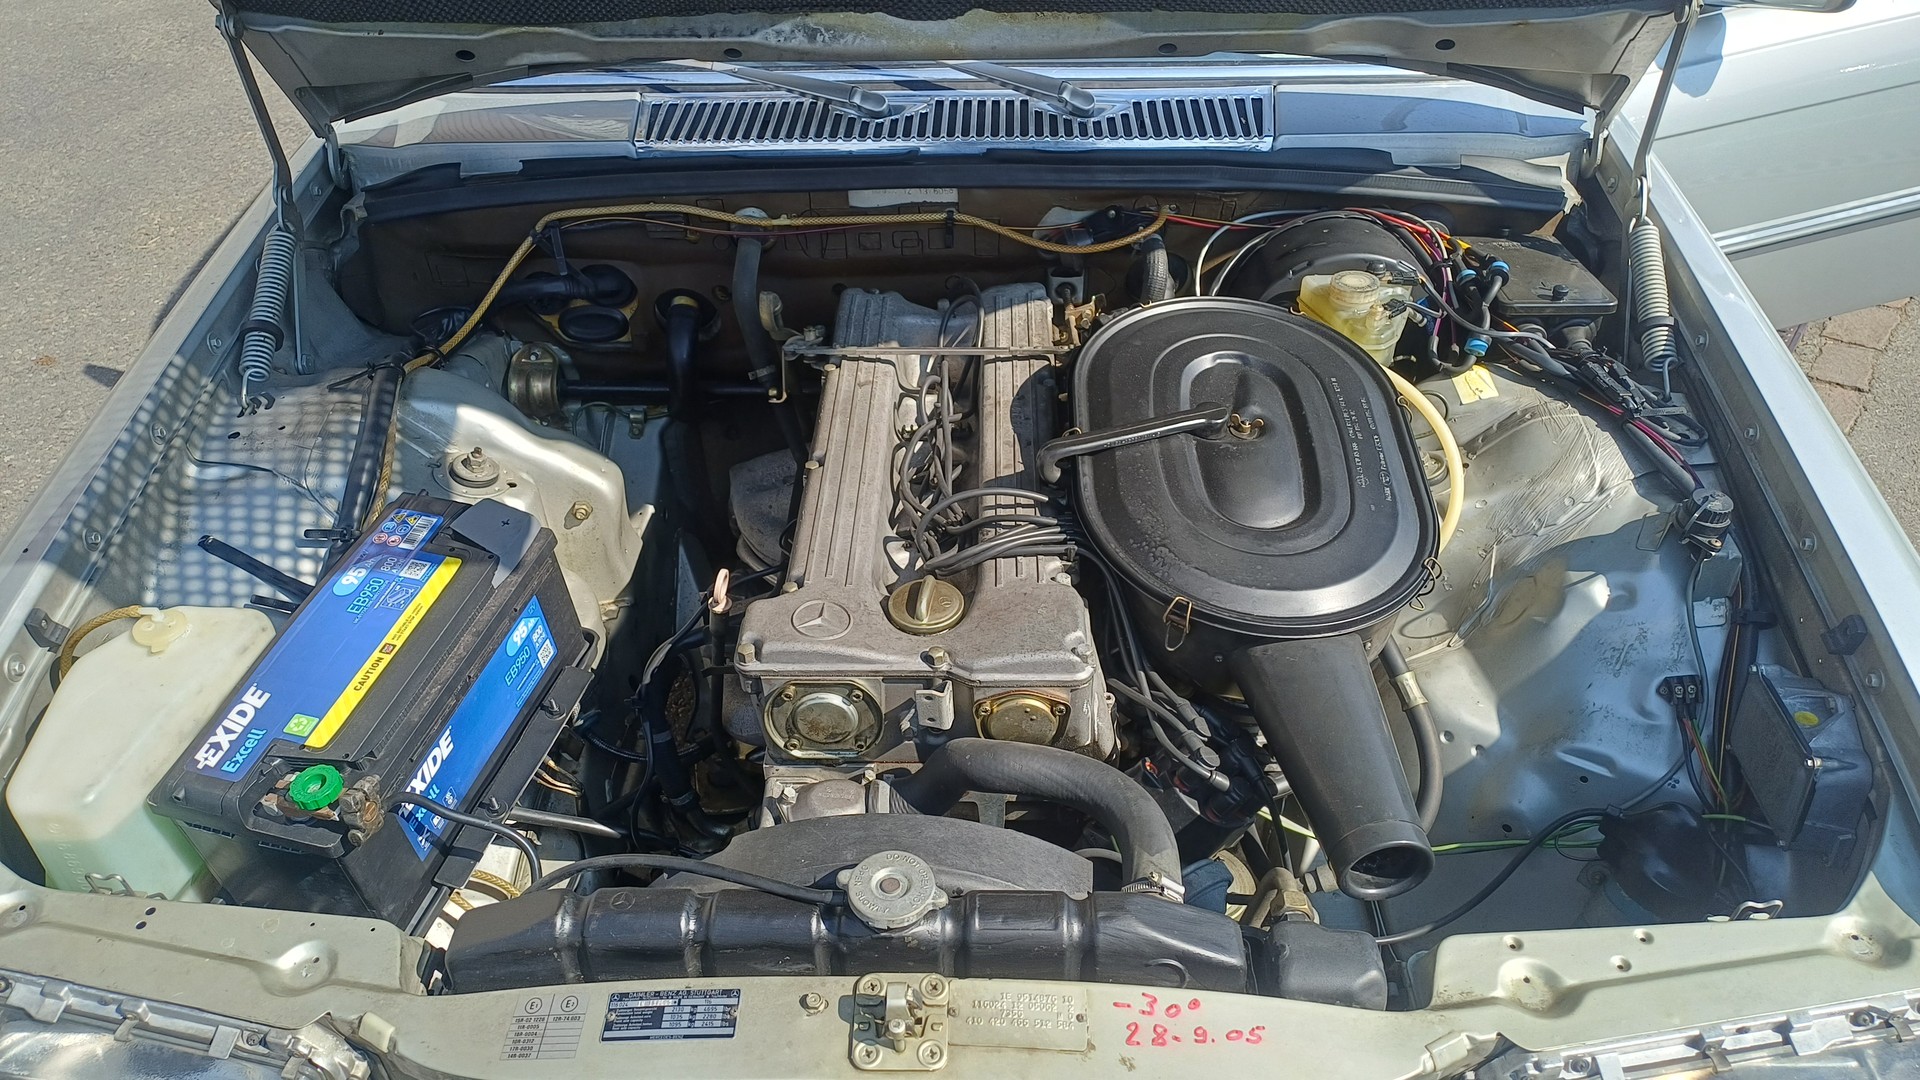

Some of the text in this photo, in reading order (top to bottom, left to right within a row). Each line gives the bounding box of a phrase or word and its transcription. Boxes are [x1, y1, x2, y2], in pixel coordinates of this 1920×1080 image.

[341, 566, 367, 585] 95
[381, 557, 397, 571] 800
[347, 578, 385, 614] EB950
[513, 620, 528, 647] 95
[532, 625, 543, 643] 800
[353, 656, 385, 692] CAUTION
[505, 646, 531, 687] EB950
[194, 685, 272, 770] EXIDE
[221, 729, 267, 773] Excell
